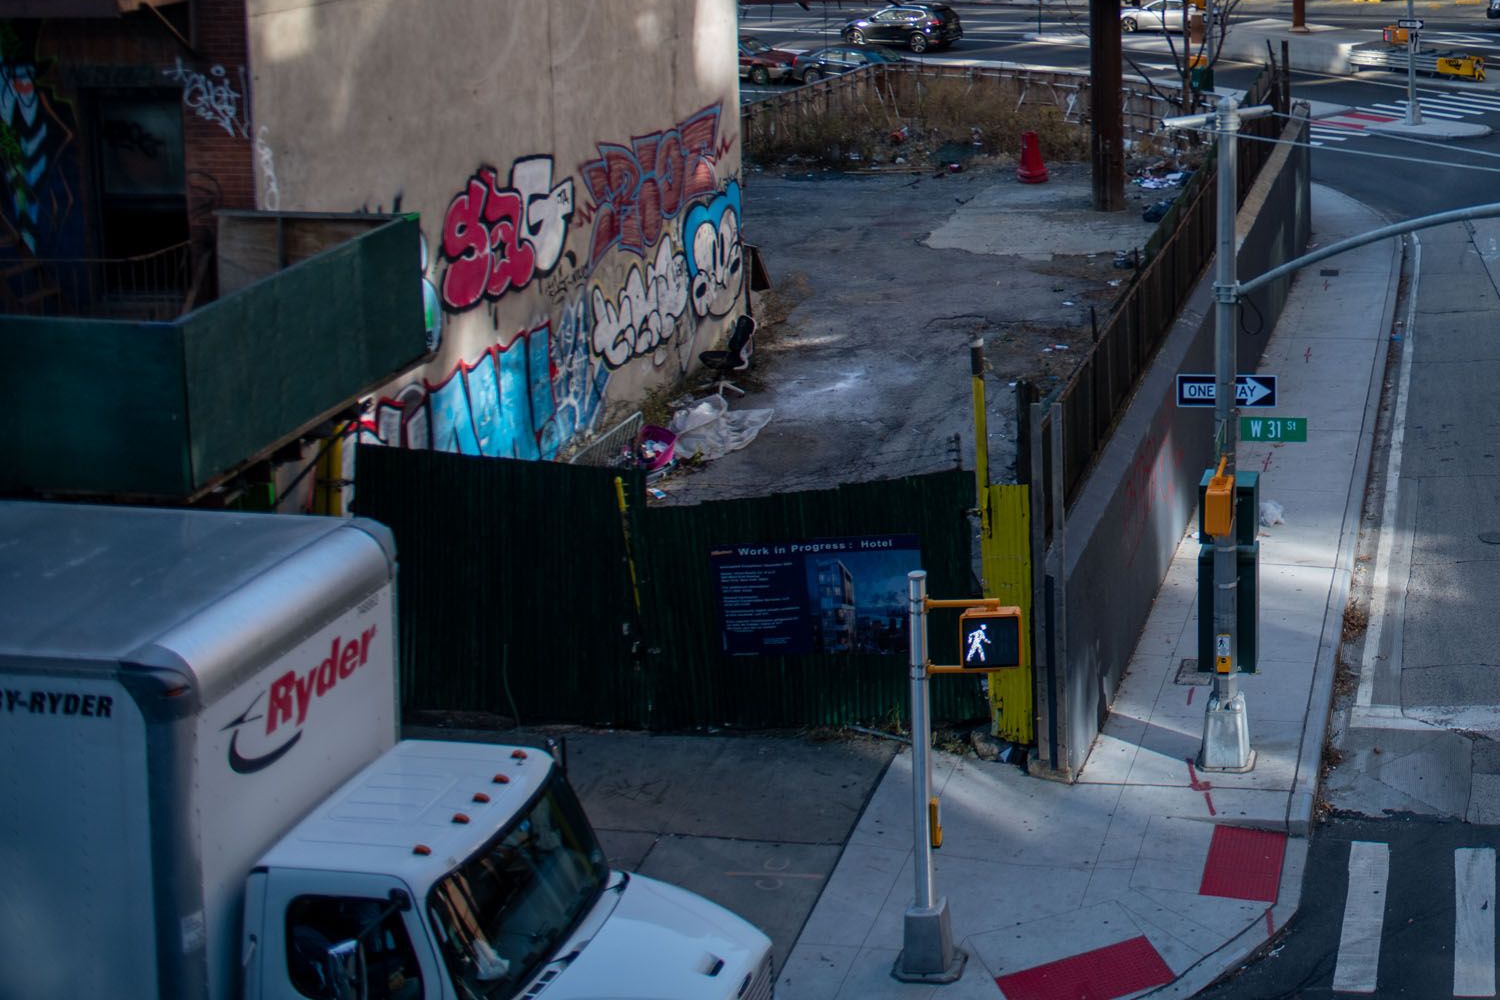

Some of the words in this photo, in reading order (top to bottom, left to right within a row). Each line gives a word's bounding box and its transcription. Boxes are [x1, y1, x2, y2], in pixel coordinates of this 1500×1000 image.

[1188, 384, 1215, 397] ONE
[1250, 420, 1262, 438] W
[1267, 420, 1281, 438] 31
[1287, 420, 1297, 431] St
[737, 547, 770, 557] Work
[774, 545, 786, 555] in
[860, 538, 893, 549] Hotel
[264, 624, 377, 736] Ryder
[0, 688, 113, 718] Y-RYDER
